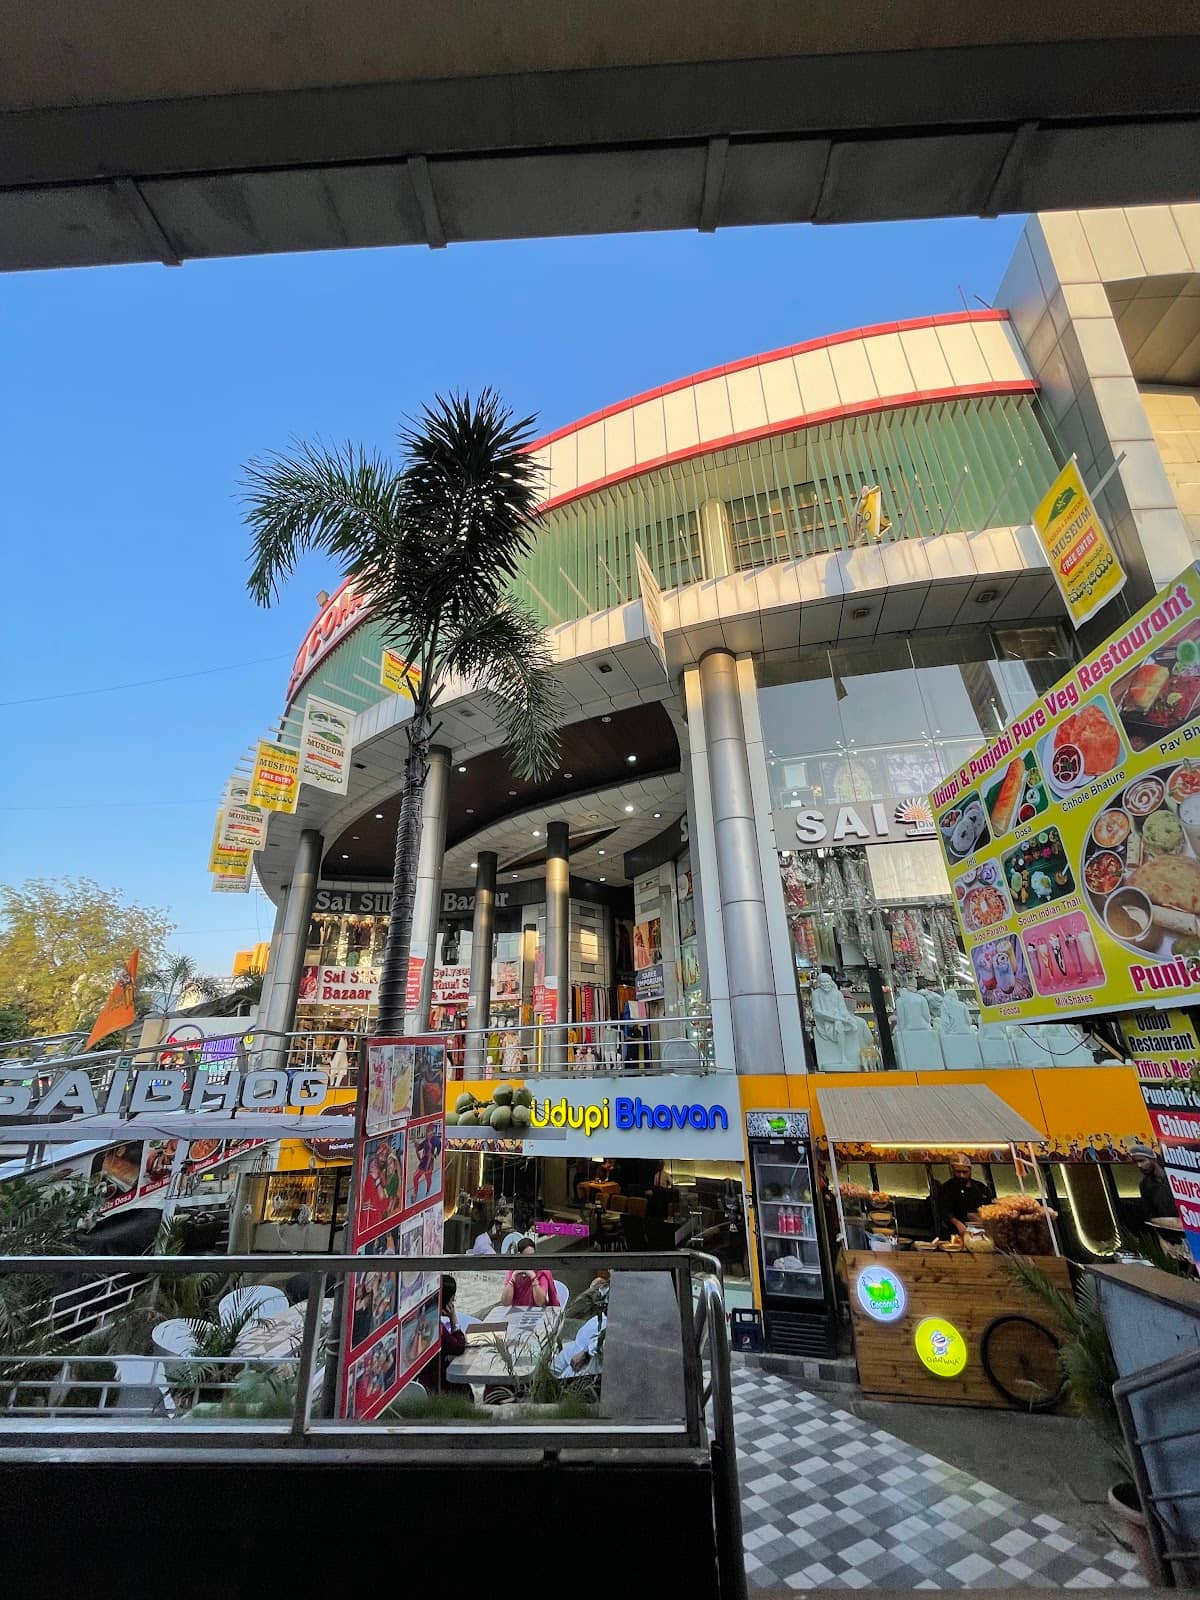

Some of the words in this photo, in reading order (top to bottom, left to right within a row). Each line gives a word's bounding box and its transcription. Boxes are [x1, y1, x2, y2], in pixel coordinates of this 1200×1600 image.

[1051, 505, 1091, 559] MUSEUM
[1062, 555, 1076, 572] FREE
[1077, 533, 1095, 556] ENTRY
[932, 780, 960, 808] Udupi
[959, 768, 971, 787] &
[969, 731, 1013, 781] Punjabi
[1013, 706, 1046, 744] Pure
[1044, 682, 1079, 716] Veg
[1077, 584, 1192, 688] Restaurant
[307, 739, 344, 757] MUSEUM
[1160, 738, 1180, 754] Pav
[259, 759, 298, 774] MUSEUM
[261, 772, 274, 781] FREE
[1090, 771, 1125, 795] Bhature
[229, 811, 263, 824] MUSEUM
[796, 803, 889, 843] SAI
[1015, 825, 1032, 839] Dosa
[315, 891, 351, 912] Sai
[359, 892, 393, 914] Sil
[1018, 912, 1037, 926] South
[1039, 905, 1061, 918] Indian
[1061, 897, 1081, 910] Thali
[323, 970, 345, 984] Sai
[322, 986, 373, 1000] Bazaar
[1136, 1012, 1171, 1032] Udupi
[1128, 1034, 1195, 1052] Restaurant
[1134, 1060, 1162, 1078] Tiffin
[1162, 1062, 1171, 1078] &
[1141, 1086, 1186, 1107] Punjabi
[530, 1097, 610, 1137] Udupi
[615, 1097, 729, 1130] Bhavan
